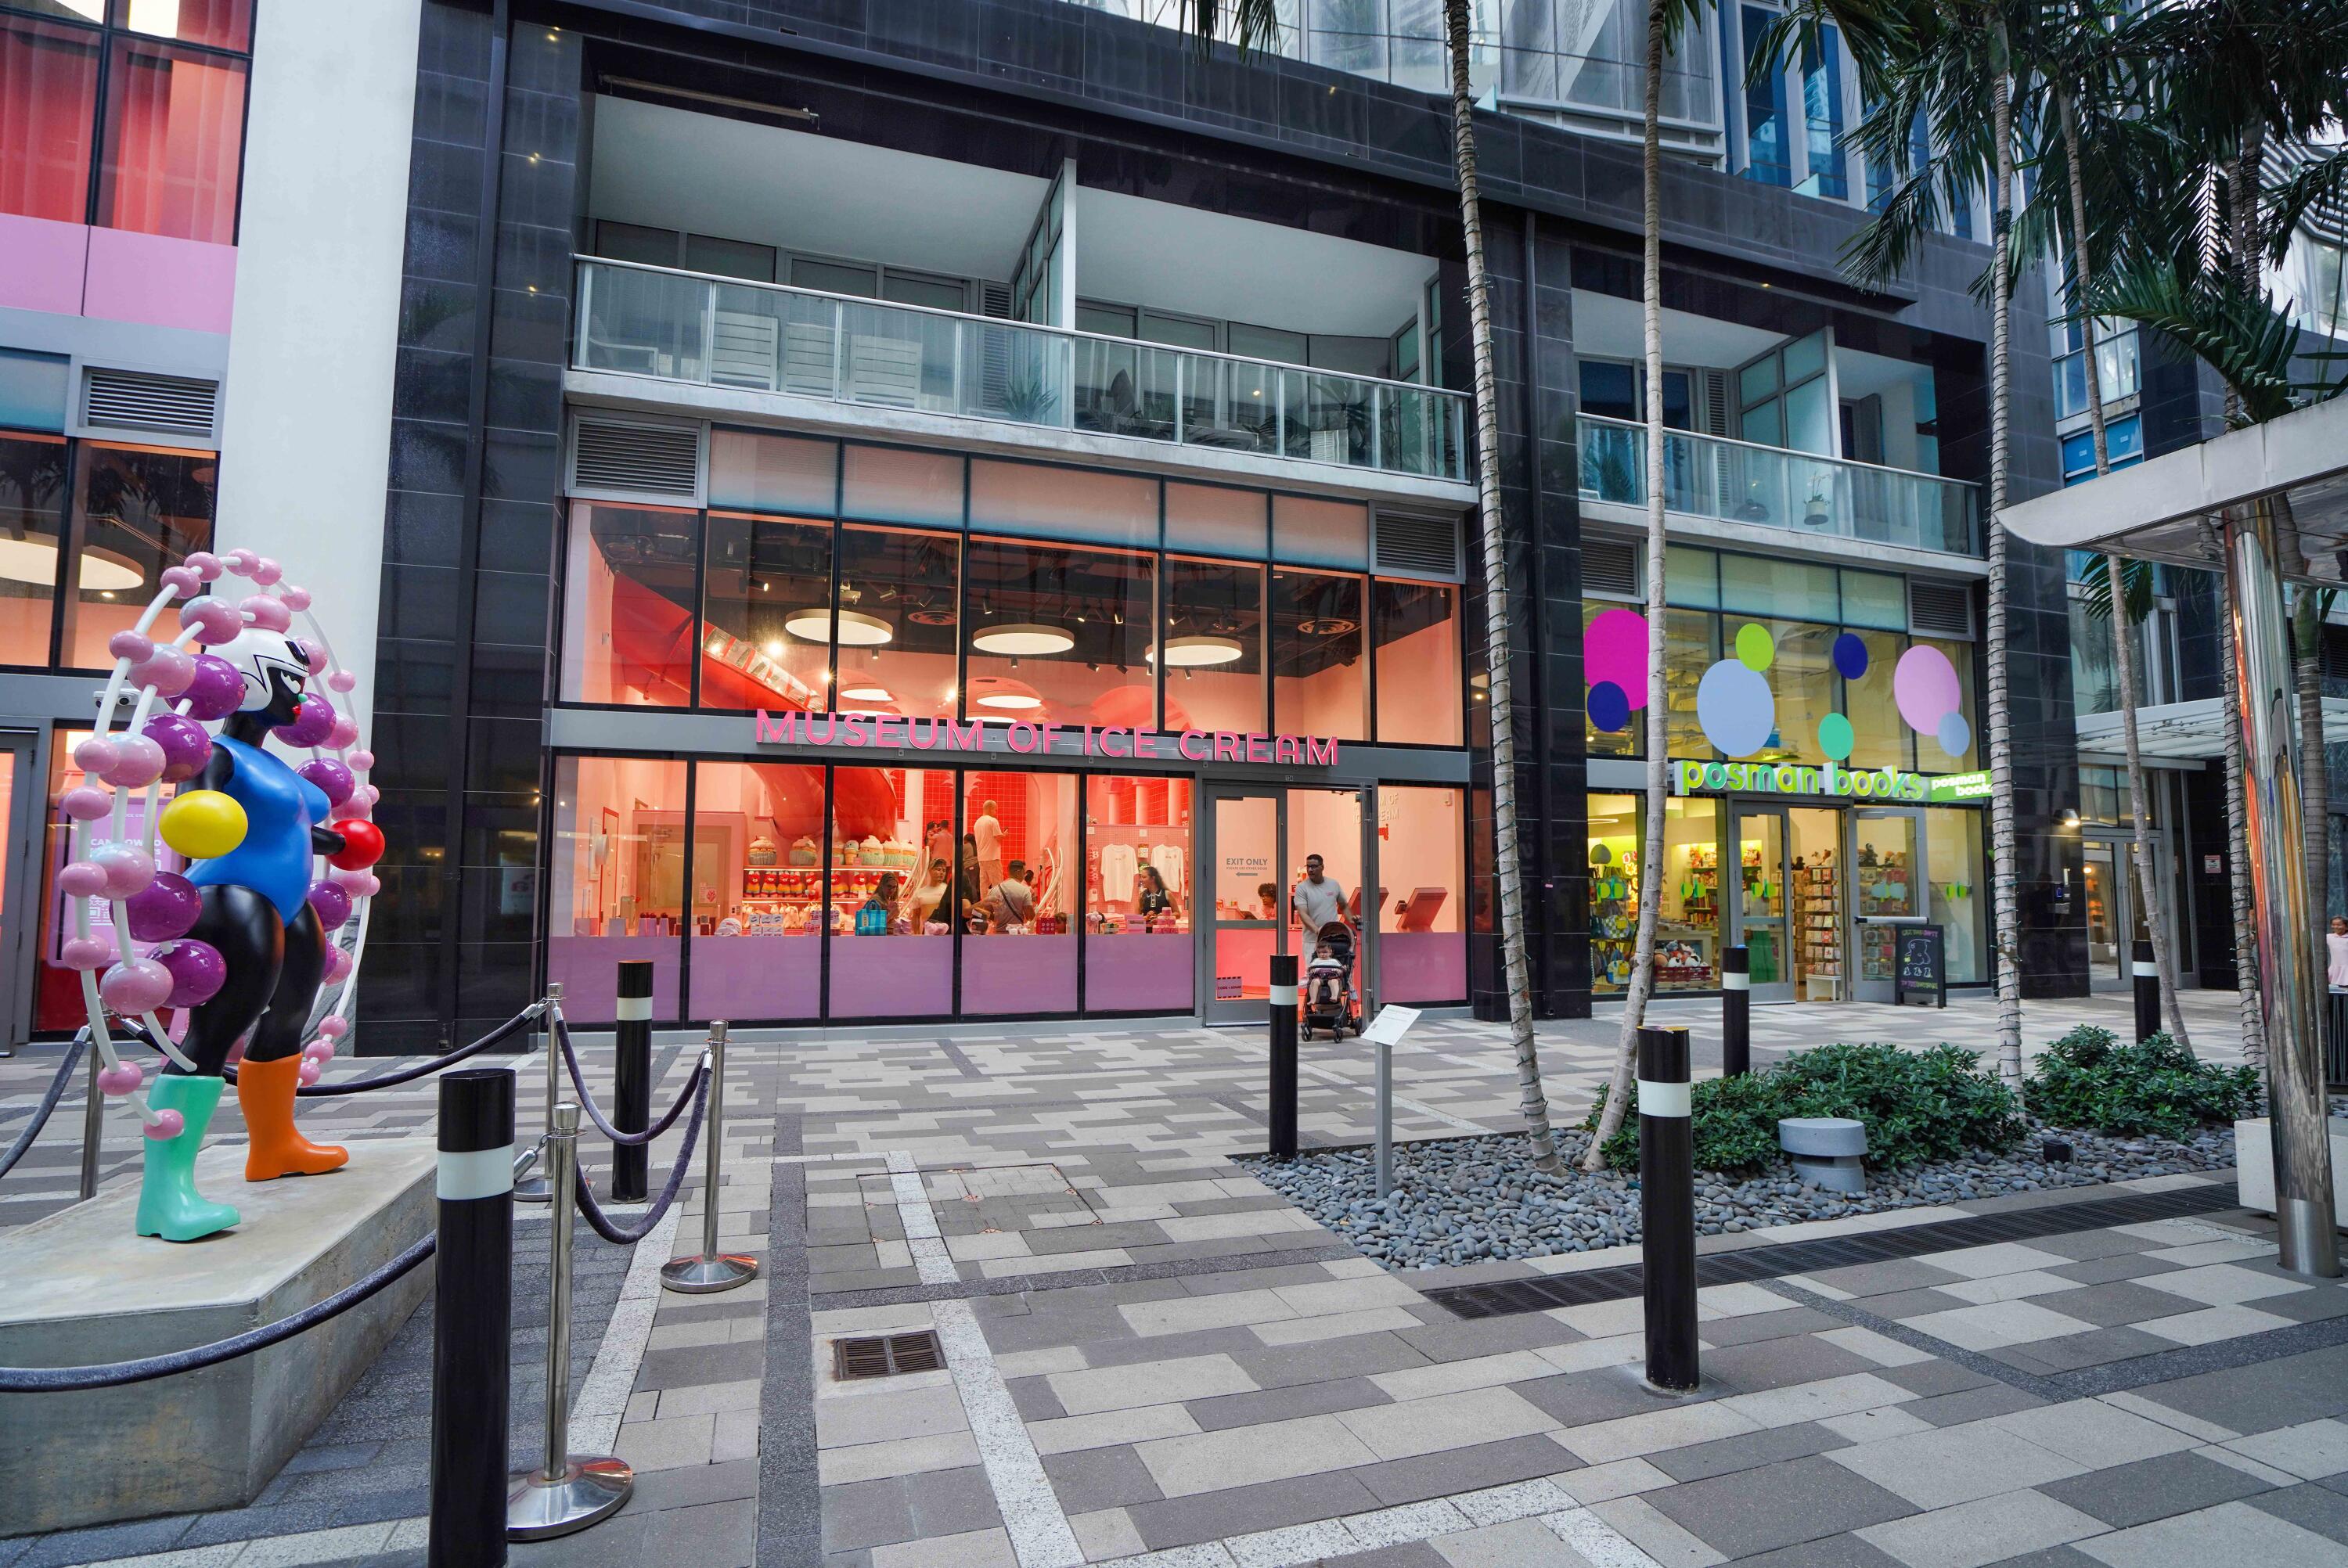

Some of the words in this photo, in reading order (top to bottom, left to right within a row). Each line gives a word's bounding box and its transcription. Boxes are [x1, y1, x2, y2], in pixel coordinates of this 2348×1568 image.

[756, 708, 984, 752] MUSEUM
[1007, 721, 1062, 754] OF
[1084, 724, 1158, 758] ICE
[1179, 728, 1339, 766] CREAM
[1679, 761, 1820, 795] posman
[1830, 761, 1924, 800] books
[1932, 773, 1986, 790] posman
[1955, 782, 1993, 797] book
